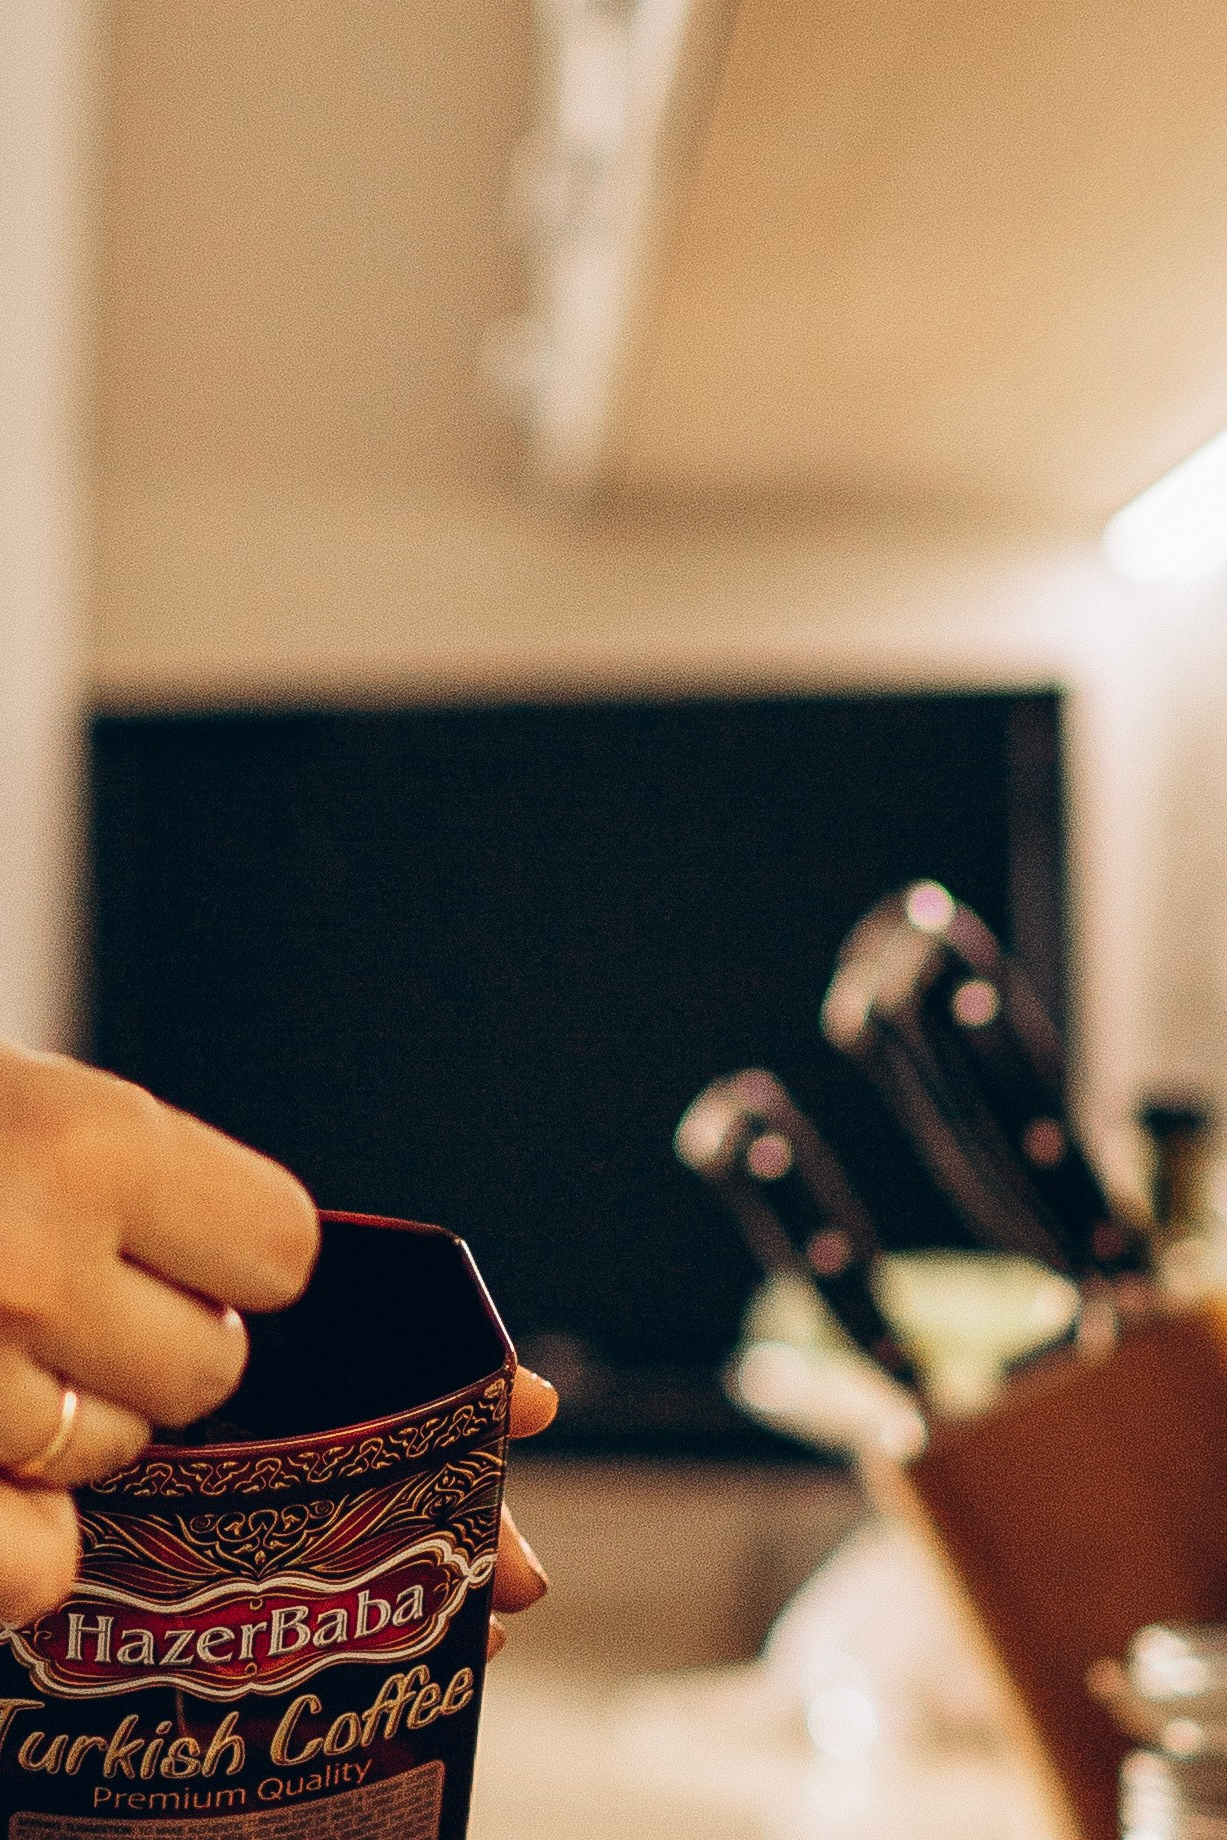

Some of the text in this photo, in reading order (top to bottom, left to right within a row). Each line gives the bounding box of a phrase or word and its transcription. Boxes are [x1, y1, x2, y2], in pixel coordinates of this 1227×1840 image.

[64, 1583, 425, 1667] HazerBaba
[270, 1663, 476, 1768] Coffee
[92, 1785, 247, 1811] Premium
[257, 1757, 374, 1802] Quality
